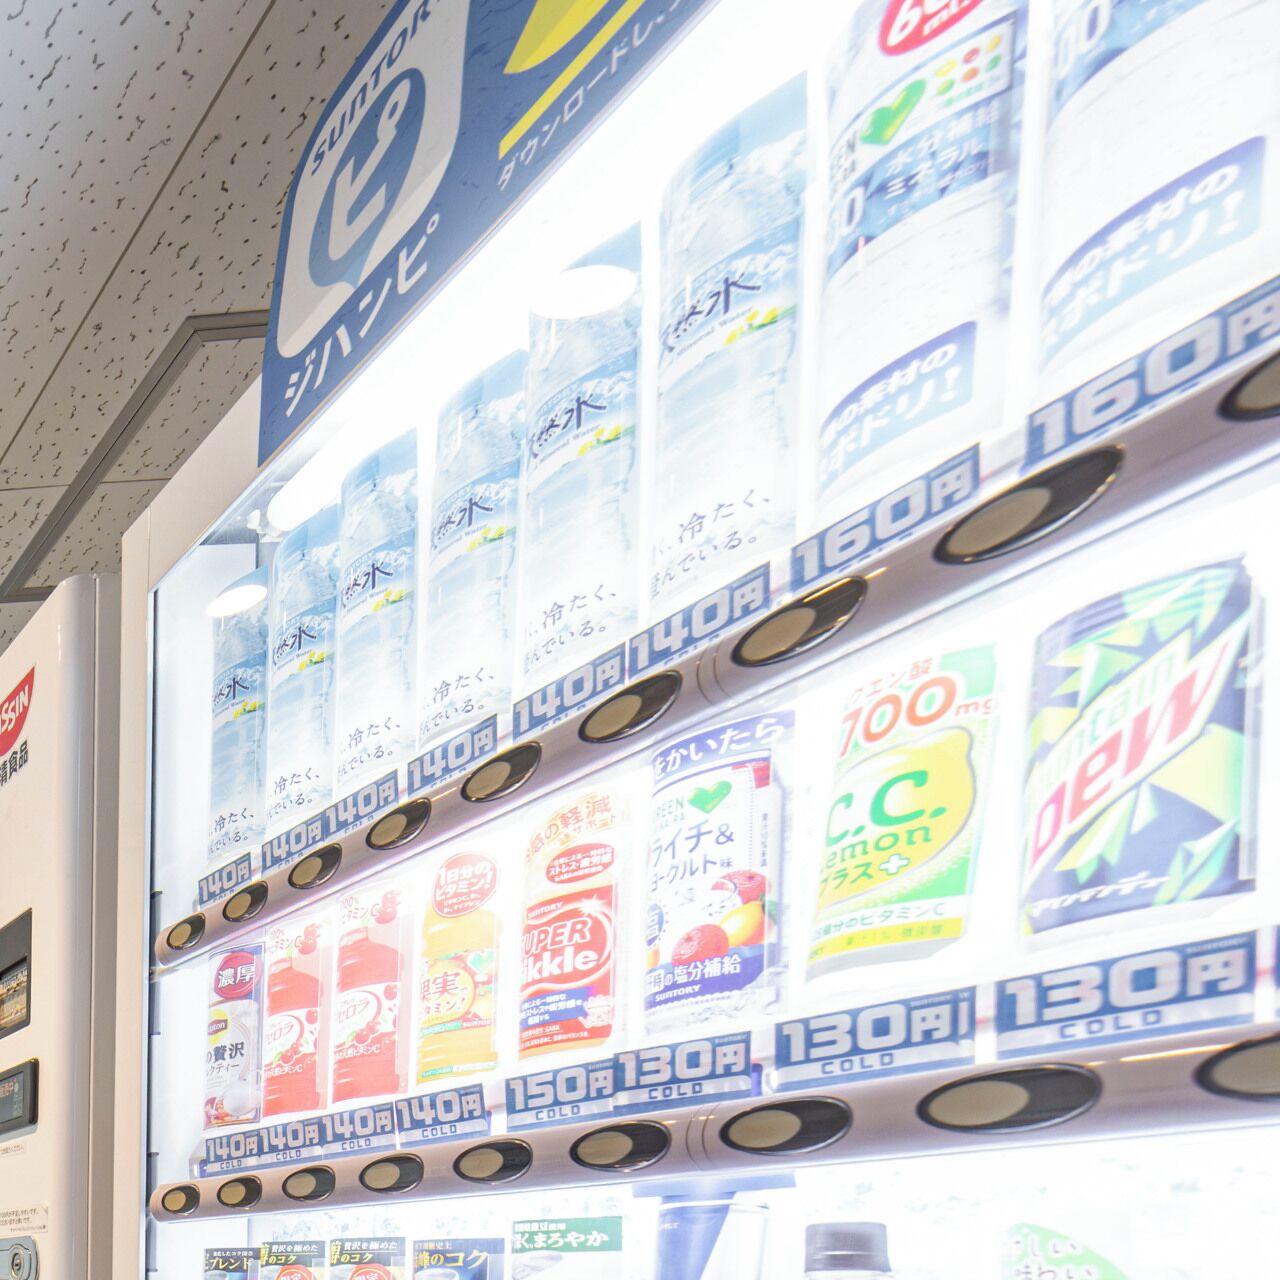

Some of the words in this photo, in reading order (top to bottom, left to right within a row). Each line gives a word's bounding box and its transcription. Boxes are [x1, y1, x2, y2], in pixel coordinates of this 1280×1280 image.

[284, 213, 440, 417] ジハンピ
[793, 458, 973, 583] 160円
[631, 578, 767, 669] 140円
[515, 656, 623, 730] 140円
[408, 722, 496, 795] 140円
[327, 780, 398, 831] 140円
[263, 819, 324, 867] 140円
[822, 825, 934, 873] emon
[199, 857, 250, 900] 140円
[218, 962, 256, 989] 濃厚
[522, 946, 599, 985] ikkle
[1004, 946, 1247, 1026] 130円
[782, 1003, 950, 1063] 130円
[1057, 1007, 1167, 1040] COLD
[618, 1040, 746, 1092] 130円
[820, 1051, 896, 1077] COLD
[510, 1064, 614, 1111] 150円
[647, 1081, 704, 1101] COLD
[322, 1106, 392, 1142] 140円
[398, 1088, 483, 1129] 140円
[534, 1103, 582, 1122] COLD
[208, 1134, 258, 1163] 140円
[259, 1119, 320, 1151] 140円
[341, 1137, 372, 1152] COLD
[421, 1123, 458, 1139] COLD
[219, 1157, 243, 1171] COLD
[275, 1148, 303, 1161] COLD
